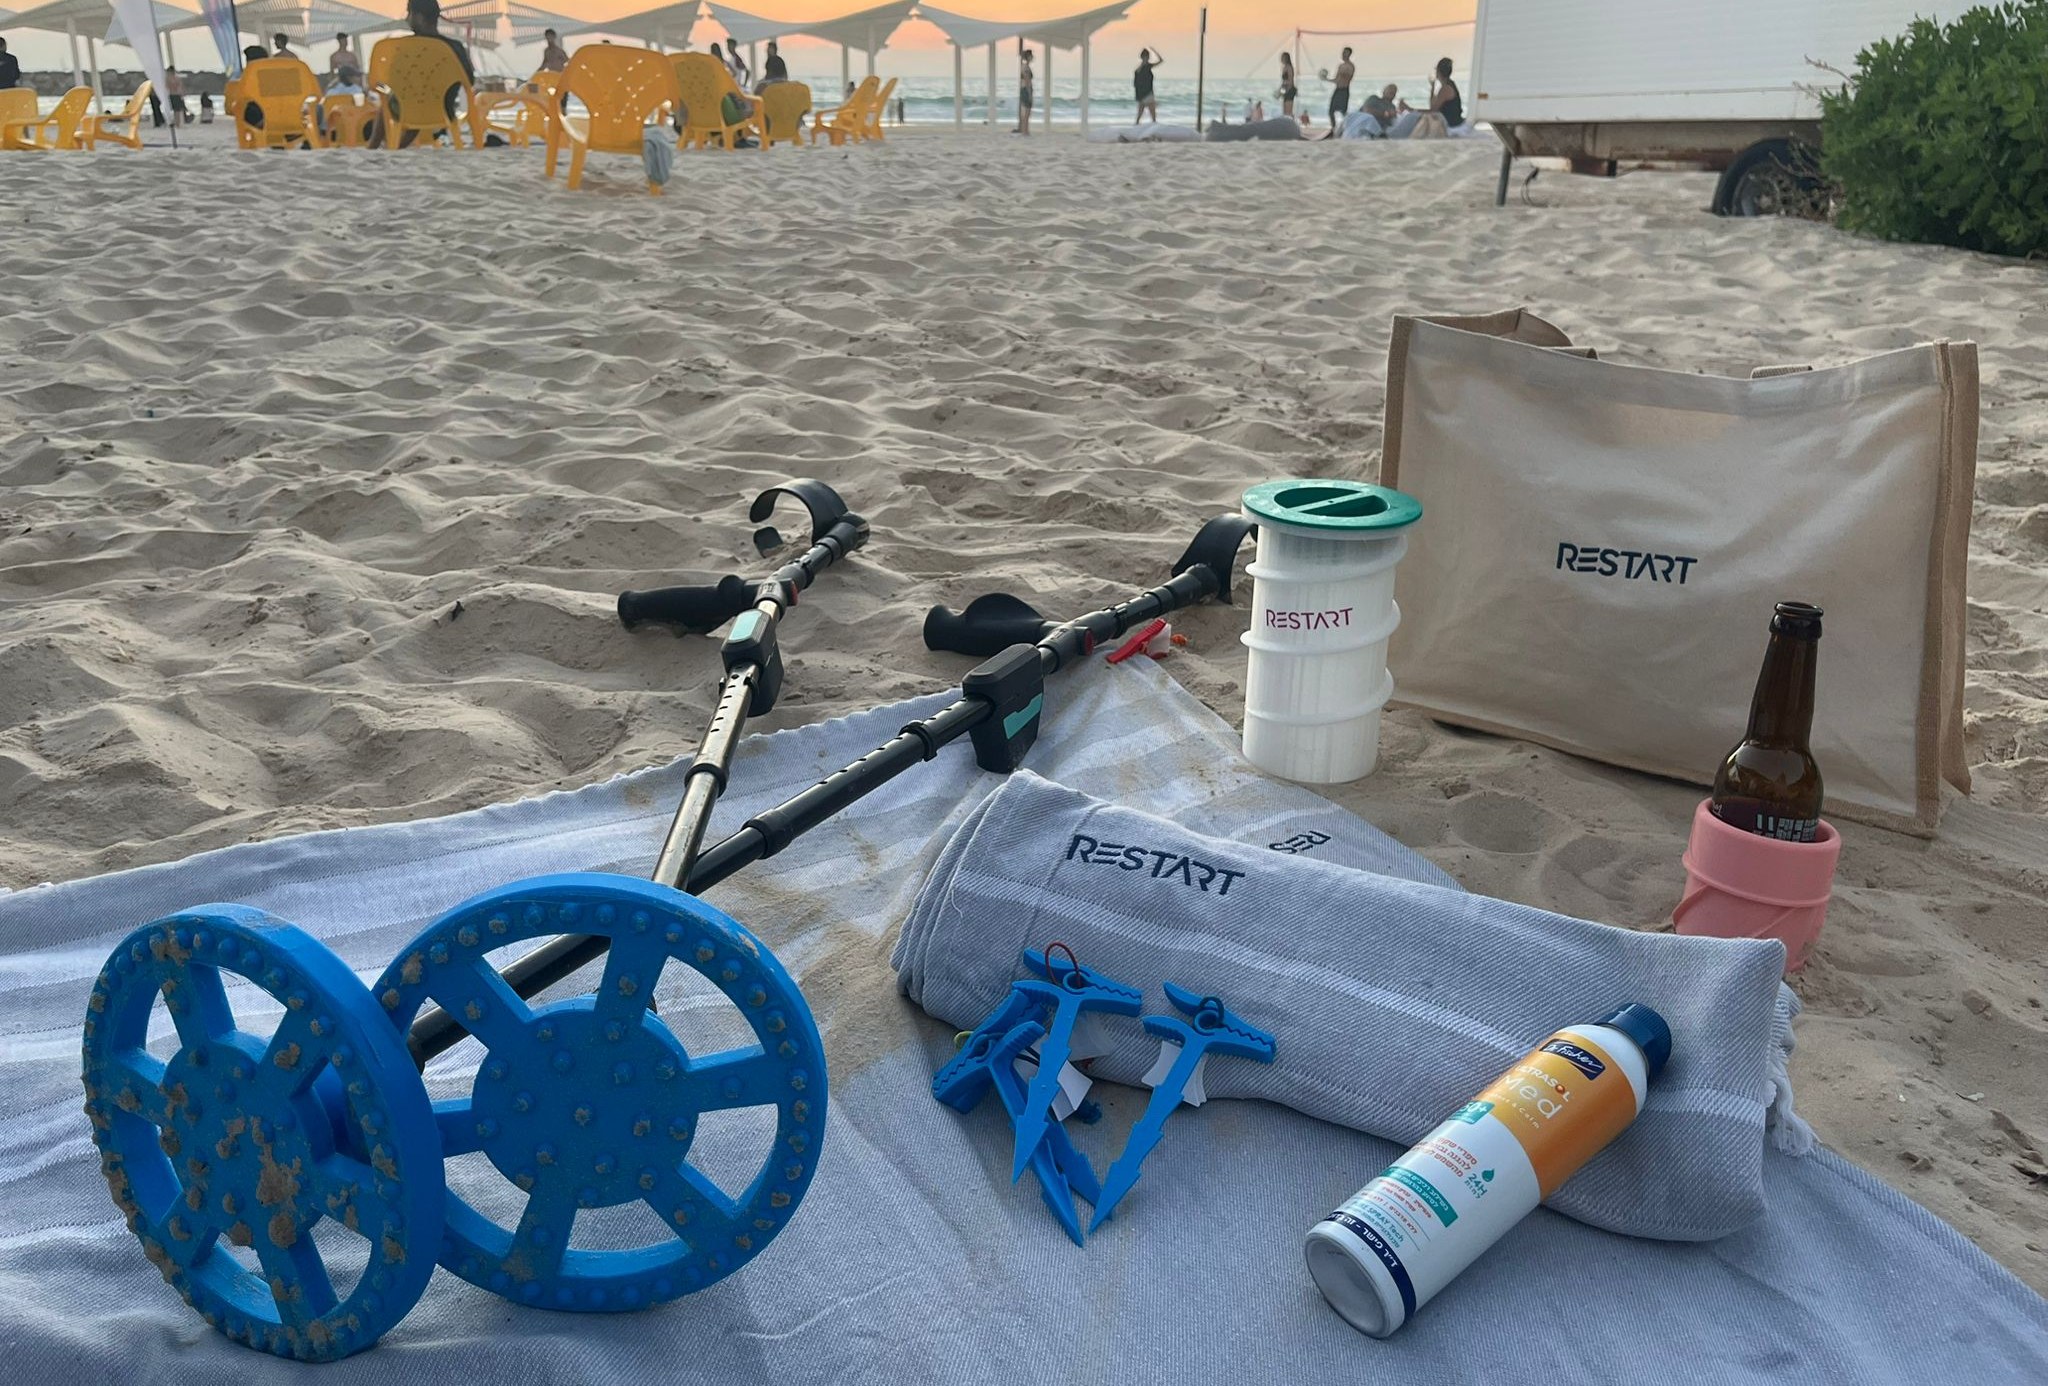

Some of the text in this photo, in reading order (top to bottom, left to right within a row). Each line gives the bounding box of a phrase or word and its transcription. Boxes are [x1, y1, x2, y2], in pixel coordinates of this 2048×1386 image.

[1556, 542, 1698, 584] RESTART
[1265, 607, 1353, 630] RESTART
[1066, 834, 1245, 896] RESTART
[1468, 1173, 1488, 1196] 24H
